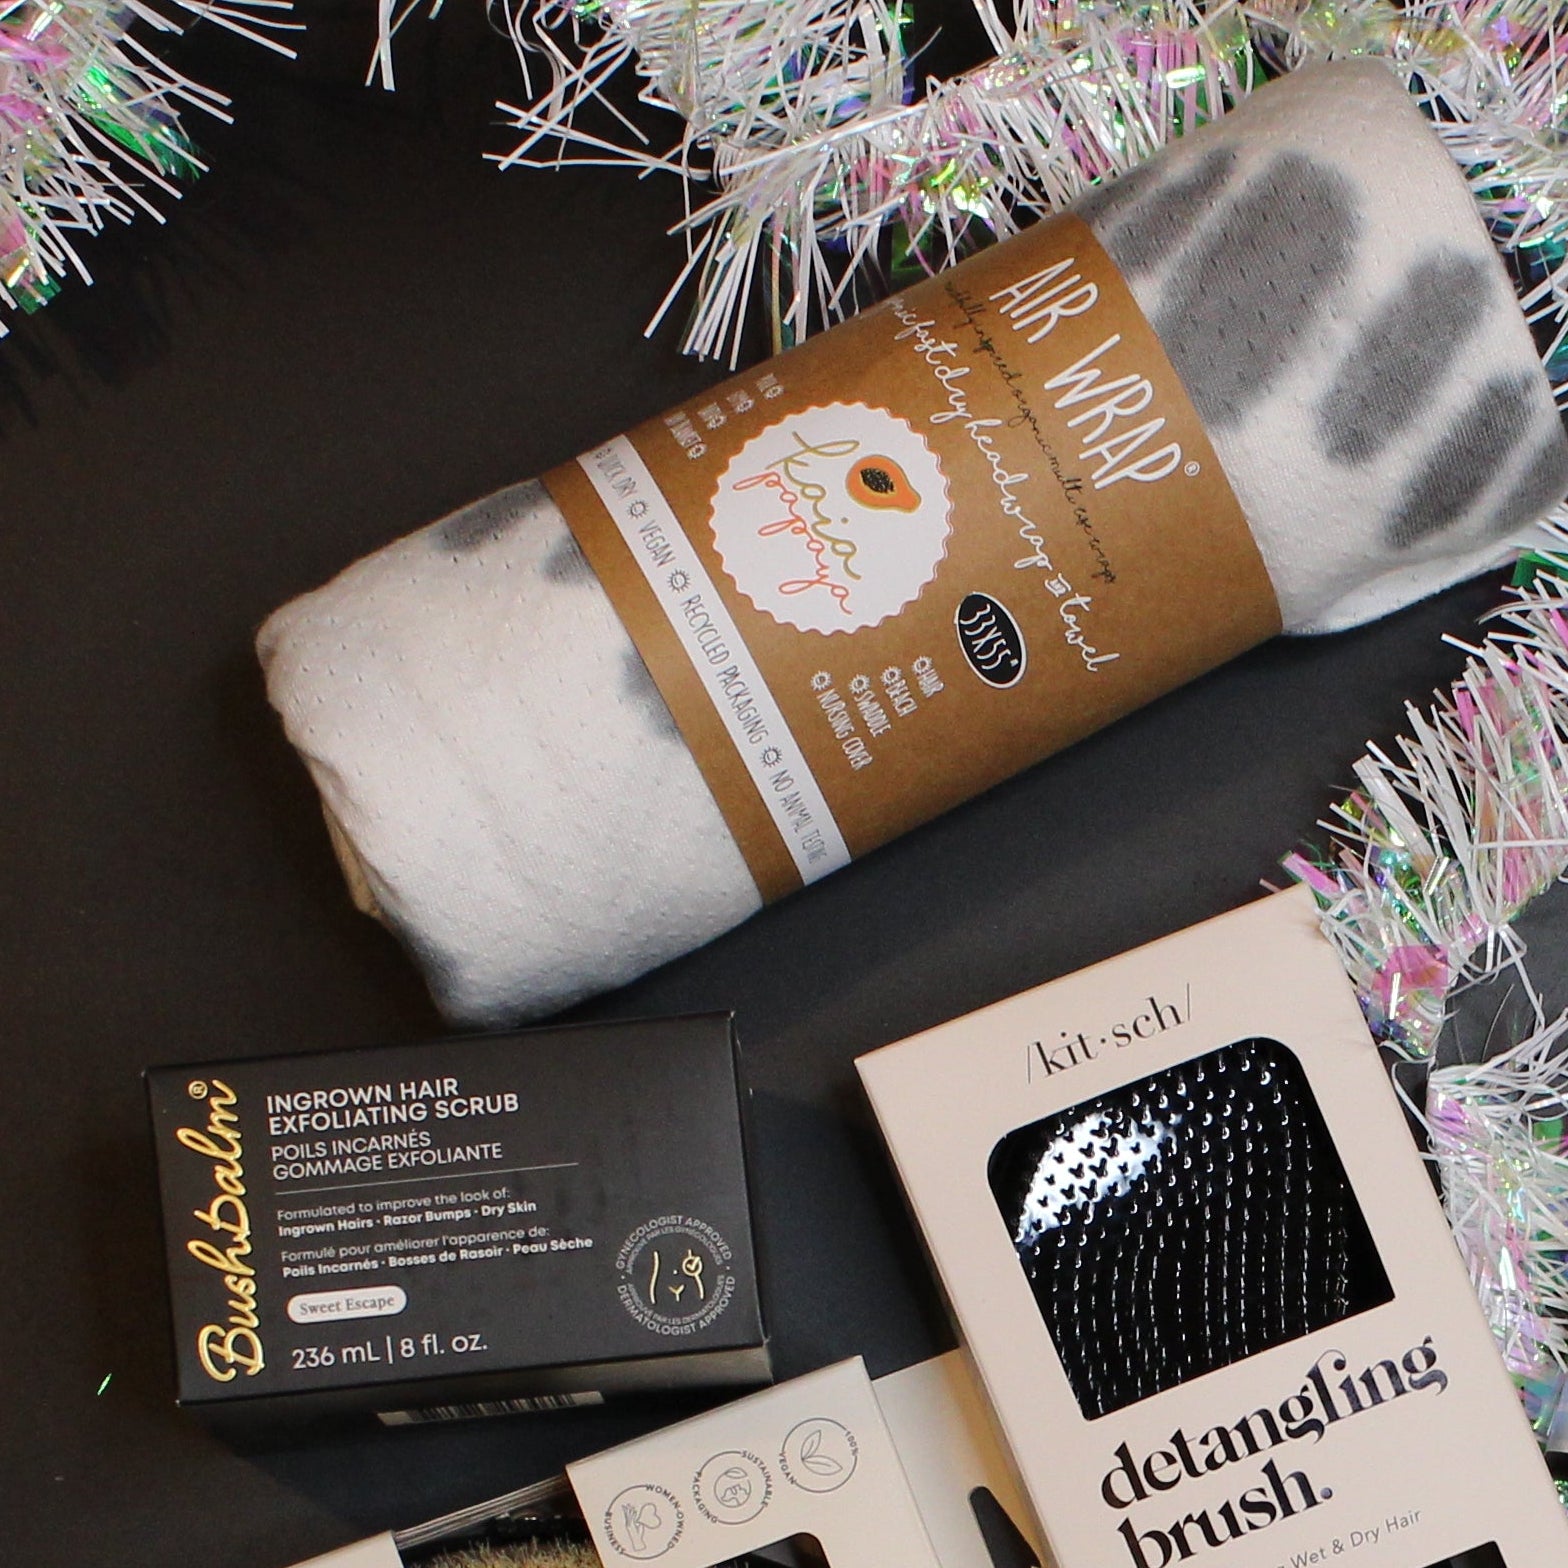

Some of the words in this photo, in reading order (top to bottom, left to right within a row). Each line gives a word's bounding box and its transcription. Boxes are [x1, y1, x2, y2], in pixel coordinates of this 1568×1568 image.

[990, 258, 1098, 343] AIR
[765, 431, 861, 580] kaia
[639, 520, 675, 567] VEGAN
[732, 469, 853, 614] papaya
[1060, 593, 1120, 671] towel
[680, 594, 729, 664] RECYCLED
[717, 666, 768, 744] PACKAGING
[917, 669, 943, 697] HAIR
[854, 690, 891, 737] SWADDLE
[886, 680, 917, 716] BEACH
[816, 688, 854, 738] NURSING
[842, 737, 872, 770] COVER
[772, 769, 795, 793] NO
[267, 1084, 391, 1114] INGROWN
[399, 1077, 459, 1101] HAIR
[269, 1103, 427, 1135] EXFOLIATING
[434, 1093, 519, 1119] SCRUB
[271, 1141, 328, 1162] POILS
[332, 1129, 430, 1155] INCARNÉS
[272, 1154, 383, 1181] GOMMAGE
[387, 1142, 503, 1169] EXFOLIANTE
[277, 1202, 356, 1221] Formulated
[357, 1202, 374, 1213] to
[375, 1197, 432, 1213] improve
[434, 1193, 458, 1205] the
[459, 1189, 491, 1203] look
[492, 1186, 511, 1200] of:
[278, 1222, 332, 1239] Ingrown
[335, 1218, 374, 1234] Hairs
[383, 1213, 423, 1227] Razor
[424, 1208, 472, 1223] Bumps
[480, 1205, 506, 1218] Dry
[507, 1200, 537, 1214] Skin
[616, 1216, 682, 1268] GYNECOLOGIST
[685, 1218, 732, 1259] APPROVED
[299, 1301, 342, 1316] Sweet
[345, 1297, 395, 1311] Escape
[618, 1285, 695, 1335] DERMATOLOGIST
[700, 1276, 735, 1328] APPROVED
[291, 1345, 335, 1369] 236
[341, 1341, 381, 1364] mL
[400, 1337, 416, 1358] 8
[420, 1333, 445, 1356] fl.
[451, 1333, 488, 1353] oz.
[844, 1430, 859, 1458] 100%
[1102, 1337, 1447, 1509] detangling
[738, 1451, 772, 1510] SUSTAINABLE
[778, 1447, 799, 1486] VEGAN
[643, 1484, 684, 1550] WOMEN-OWNED
[692, 1472, 718, 1523] PACKAGING
[603, 1509, 626, 1555] BUSINESS
[1332, 1538, 1345, 1555] &
[1349, 1527, 1380, 1548] Dry
[1385, 1510, 1421, 1533] Hair
